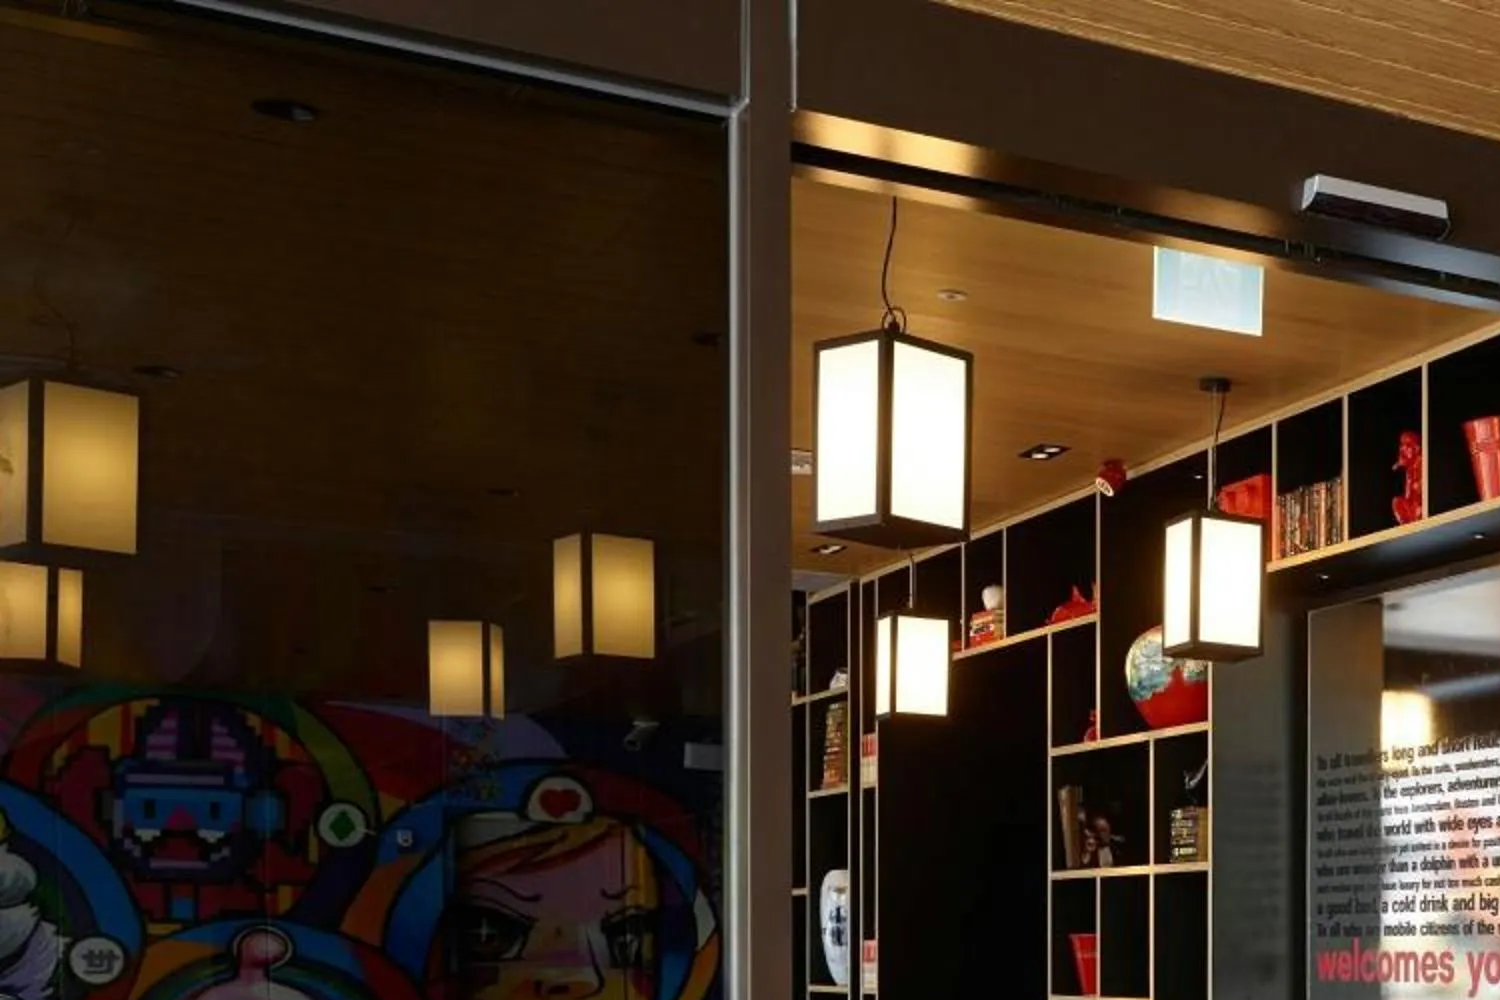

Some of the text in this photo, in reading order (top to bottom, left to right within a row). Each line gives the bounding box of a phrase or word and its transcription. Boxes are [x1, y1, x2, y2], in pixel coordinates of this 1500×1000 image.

[1392, 744, 1414, 763] long
[1418, 737, 1438, 757] and
[1467, 815, 1493, 834] eyes
[1411, 861, 1418, 872] a
[1420, 855, 1456, 876] dolphin
[1482, 857, 1489, 868] a
[1382, 901, 1389, 913] a
[1391, 895, 1416, 912] cold
[1420, 893, 1449, 912] drink
[1452, 892, 1475, 911] and
[1479, 891, 1499, 917] big
[1383, 922, 1417, 937] mobile
[1419, 921, 1459, 937] citizens
[1461, 919, 1476, 936] of
[1477, 919, 1495, 935] the
[1316, 936, 1455, 983] welcomes
